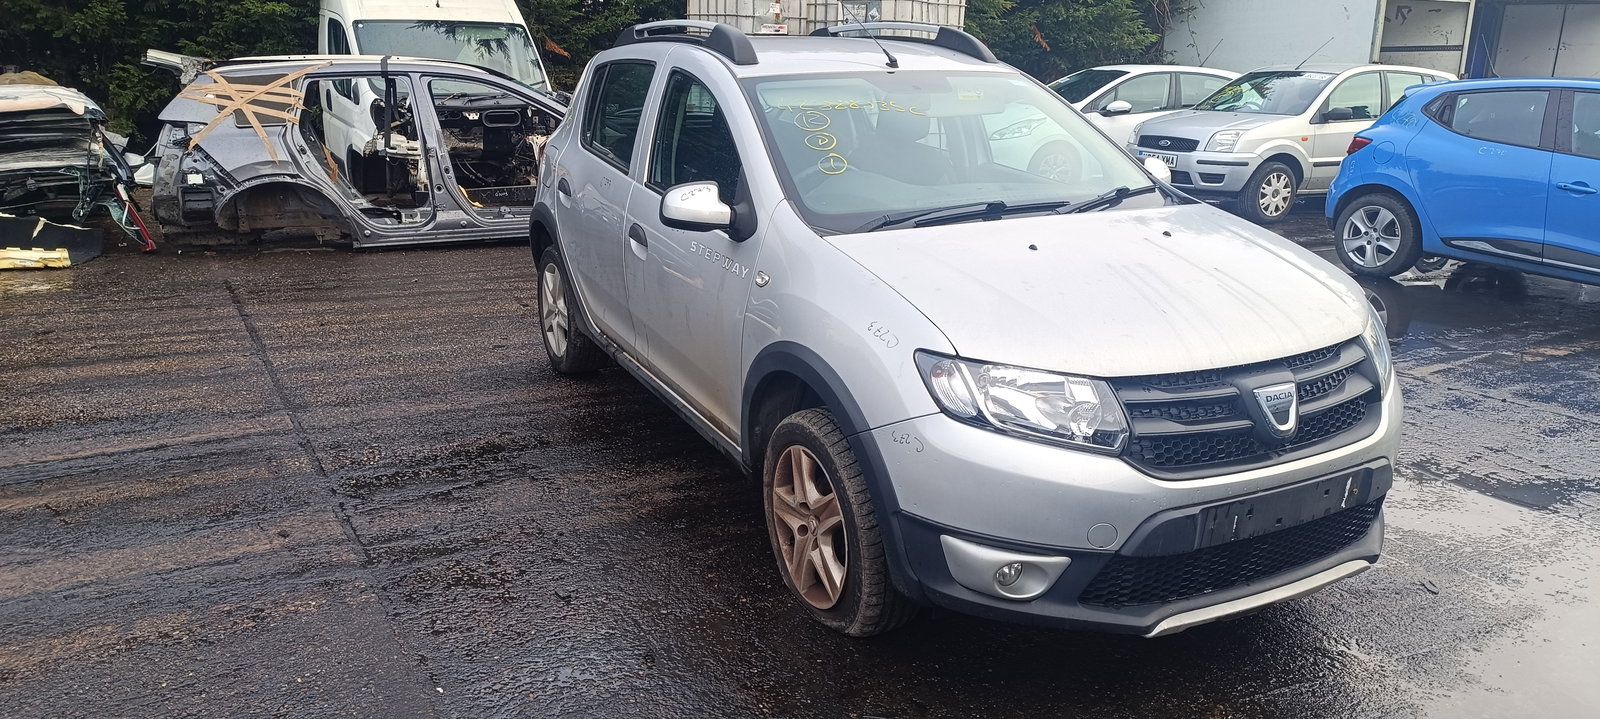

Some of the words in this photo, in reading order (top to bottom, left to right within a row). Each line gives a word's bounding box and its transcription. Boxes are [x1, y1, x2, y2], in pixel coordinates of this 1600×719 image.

[690, 241, 749, 278] STEPWAY
[867, 321, 899, 348] C273
[1265, 391, 1294, 403] DACIA
[891, 430, 924, 453] C273
